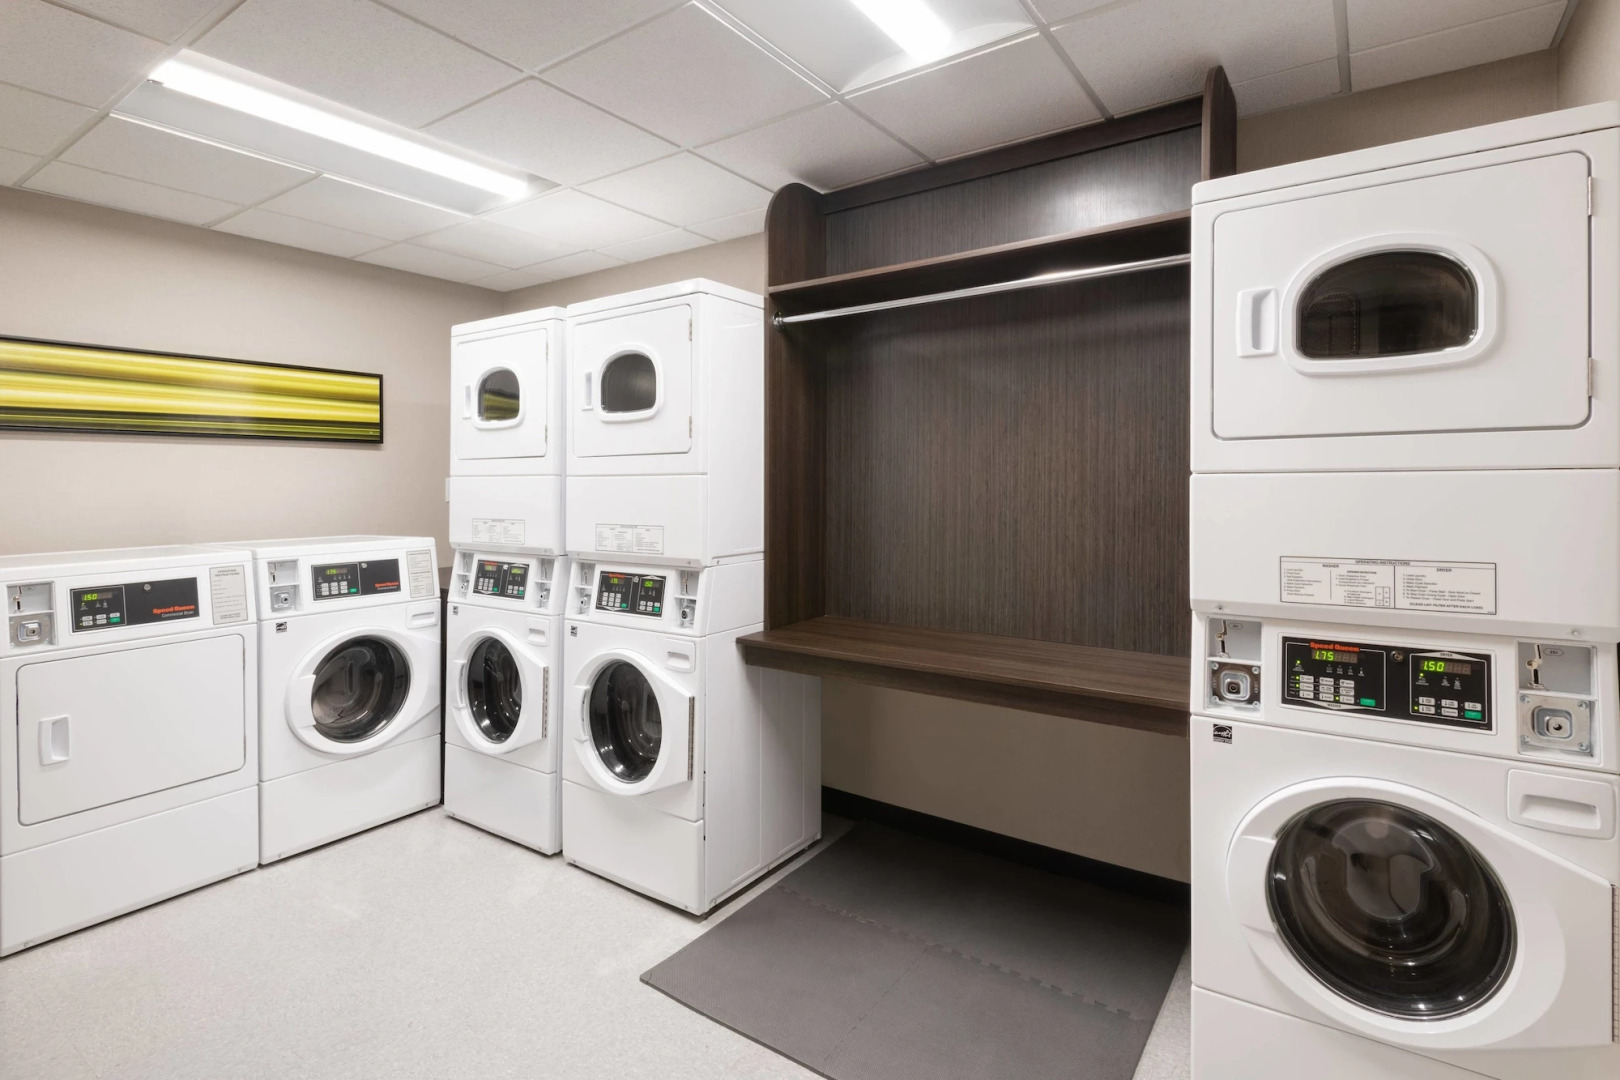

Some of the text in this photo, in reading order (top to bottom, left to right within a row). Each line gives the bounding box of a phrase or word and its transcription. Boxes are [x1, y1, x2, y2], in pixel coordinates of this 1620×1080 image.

[153, 606, 174, 614] Speed
[1310, 641, 1360, 652] Speed Queen
